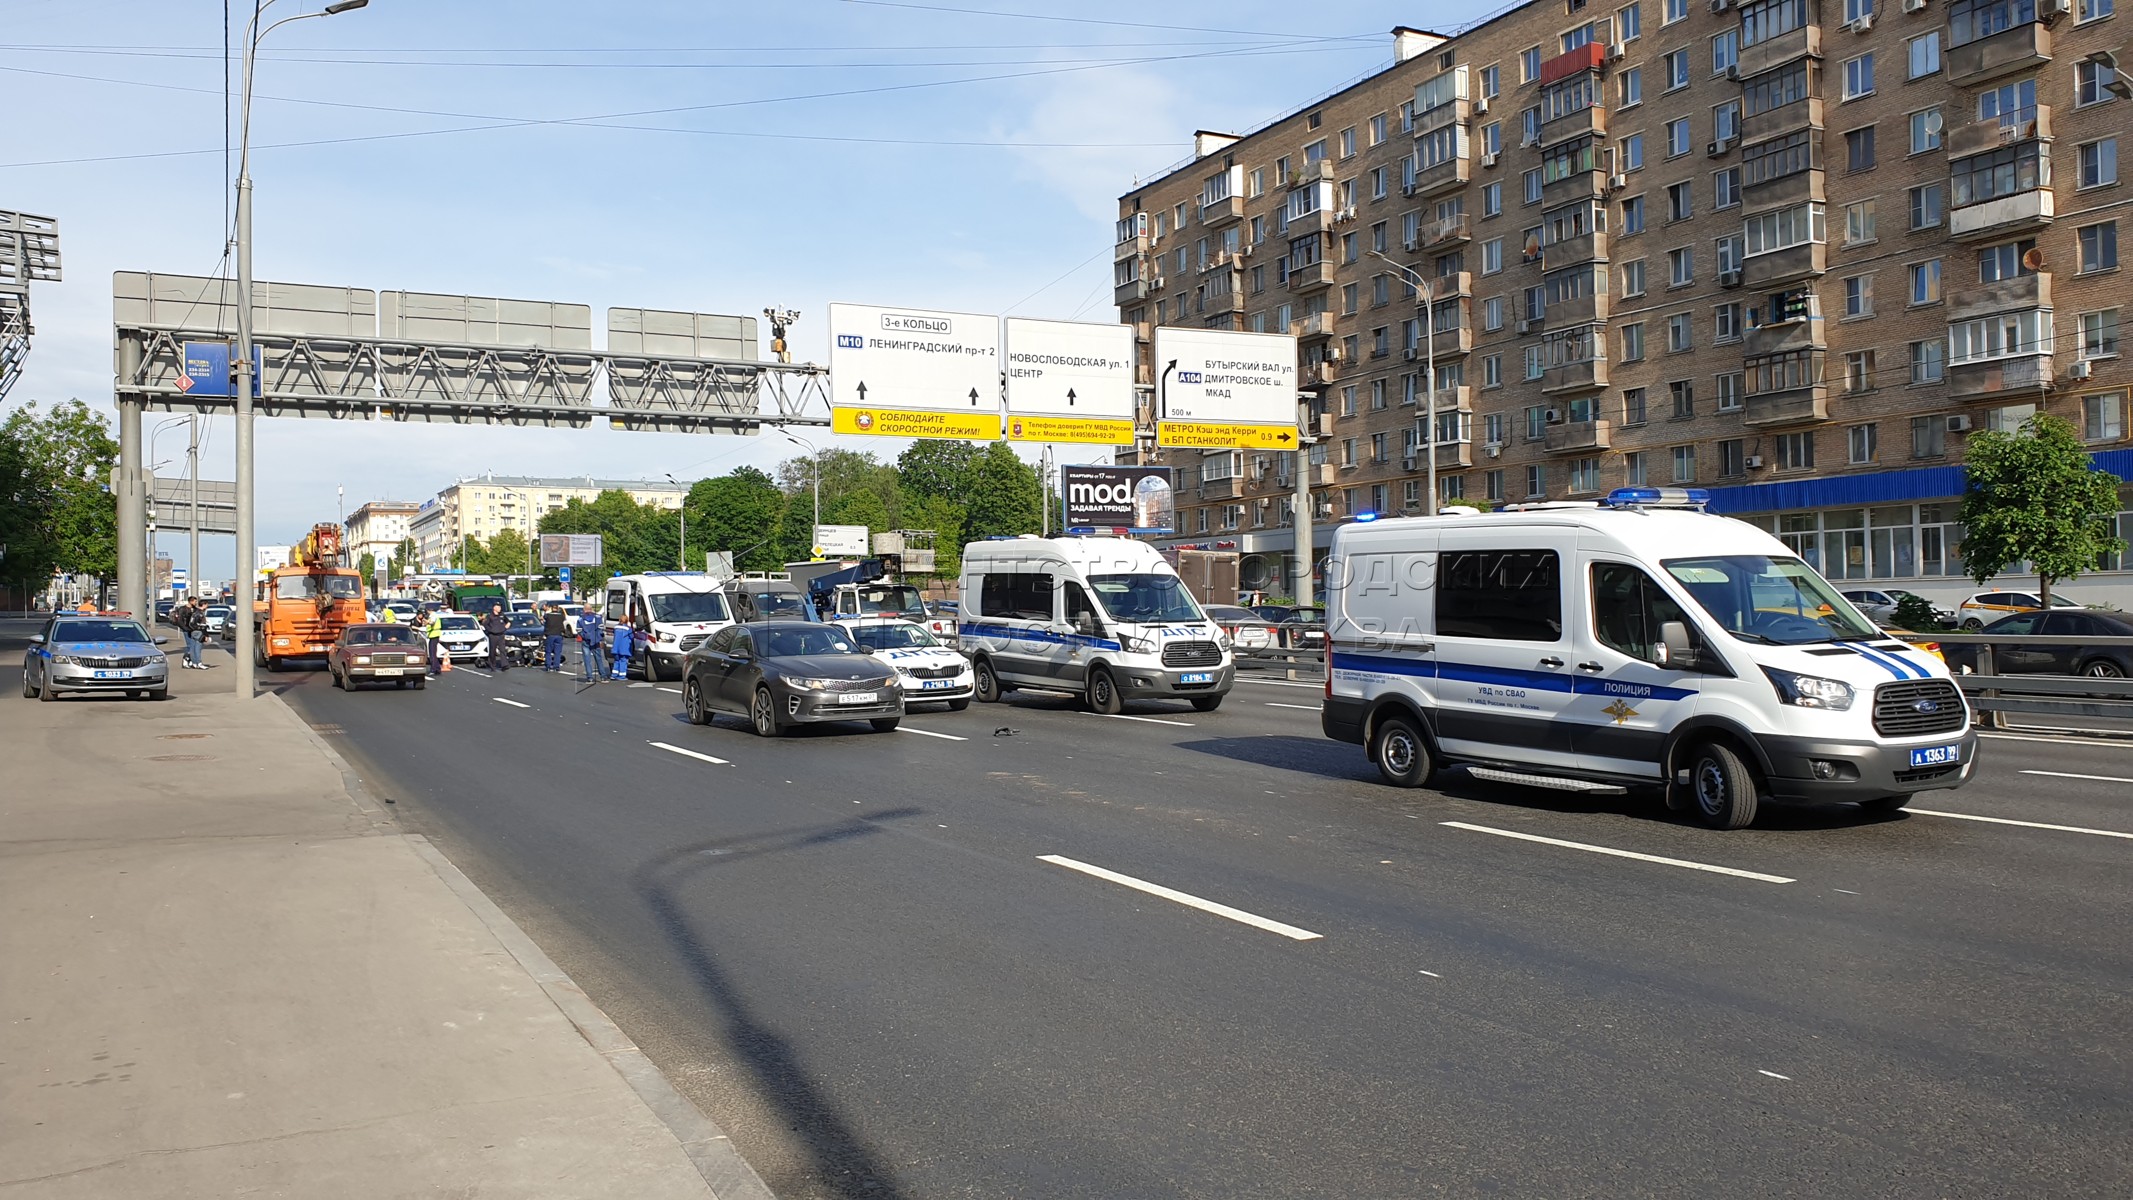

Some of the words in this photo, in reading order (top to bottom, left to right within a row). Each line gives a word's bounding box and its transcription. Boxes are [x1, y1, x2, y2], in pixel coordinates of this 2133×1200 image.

[885, 317, 900, 328] 3-е
[903, 319, 948, 331] КОЛЬЦО
[839, 336, 862, 347] М10
[869, 338, 962, 354] ЛЕНИНГРАДСКИЙ
[965, 347, 986, 357] пр-т
[989, 347, 995, 356] 2
[1009, 353, 1106, 367] НОВОСЛОБОДСКАЯ
[1109, 361, 1122, 370] ул.
[1125, 360, 1129, 368] 1
[1205, 360, 1259, 371] БУТЫРСКИЙ
[1262, 363, 1280, 372] ВАЛ
[1281, 365, 1294, 374] ул.
[1010, 368, 1043, 378] ЦЕНТР
[1179, 372, 1201, 383] А104
[1204, 374, 1272, 386] ДМИТРОВСКОЕ
[1205, 389, 1231, 399] МКАД
[880, 412, 945, 424] СОБЛЮДАЙТЕ
[1171, 408, 1184, 417] 500
[1028, 421, 1056, 429] Телефон
[1164, 424, 1194, 433] МЕТРО
[1196, 426, 1213, 434] Кэш
[1215, 427, 1230, 435] энд
[1232, 427, 1257, 436] Керри
[944, 426, 980, 436] РЕЖИМ!
[1172, 436, 1184, 444] БП
[1186, 437, 1237, 445] СТАНКОЛИТ
[1069, 478, 1137, 504] mod.
[1070, 504, 1103, 512] ЗАДАВАЯ
[1103, 505, 1132, 513] ТРЕНДЫ
[1161, 627, 1207, 637] ДПС
[889, 650, 952, 660] ДПС
[1478, 686, 1493, 697] УВД
[1495, 689, 1504, 697] по
[1505, 688, 1526, 698] СВАО
[1604, 682, 1651, 697] ПОЛИЦИЯ
[1474, 698, 1487, 706] МВД
[1924, 747, 1945, 762] 1363
[1948, 745, 1956, 755] 99
